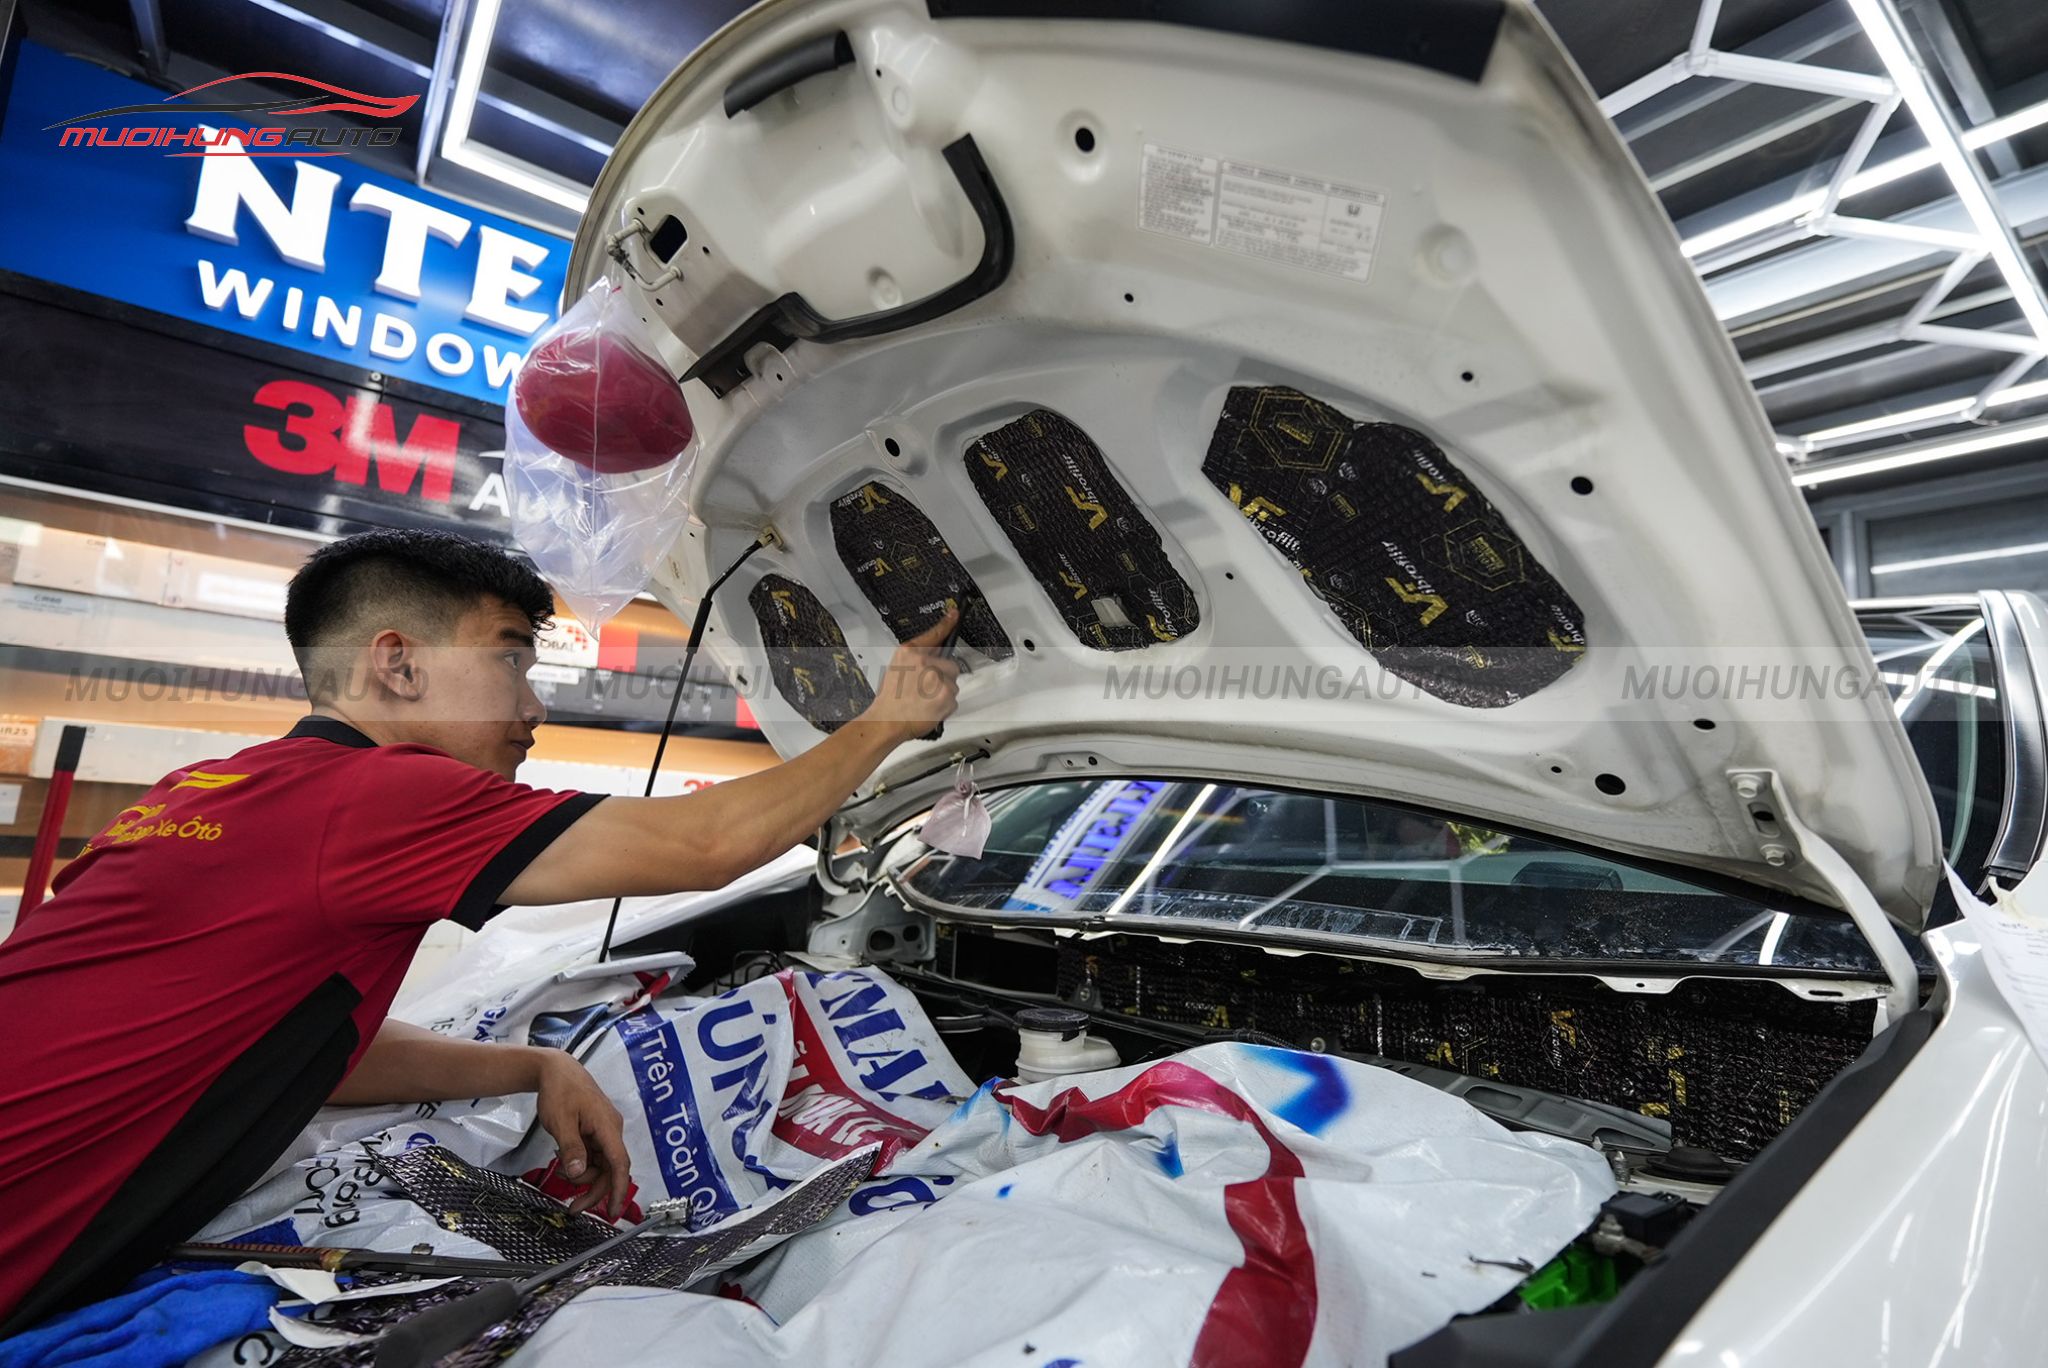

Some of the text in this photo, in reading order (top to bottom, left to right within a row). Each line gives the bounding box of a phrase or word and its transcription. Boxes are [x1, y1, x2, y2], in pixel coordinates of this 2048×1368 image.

[243, 380, 461, 503] 3M
[639, 1029, 675, 1103] Trên
[661, 1102, 701, 1185] Toàn
